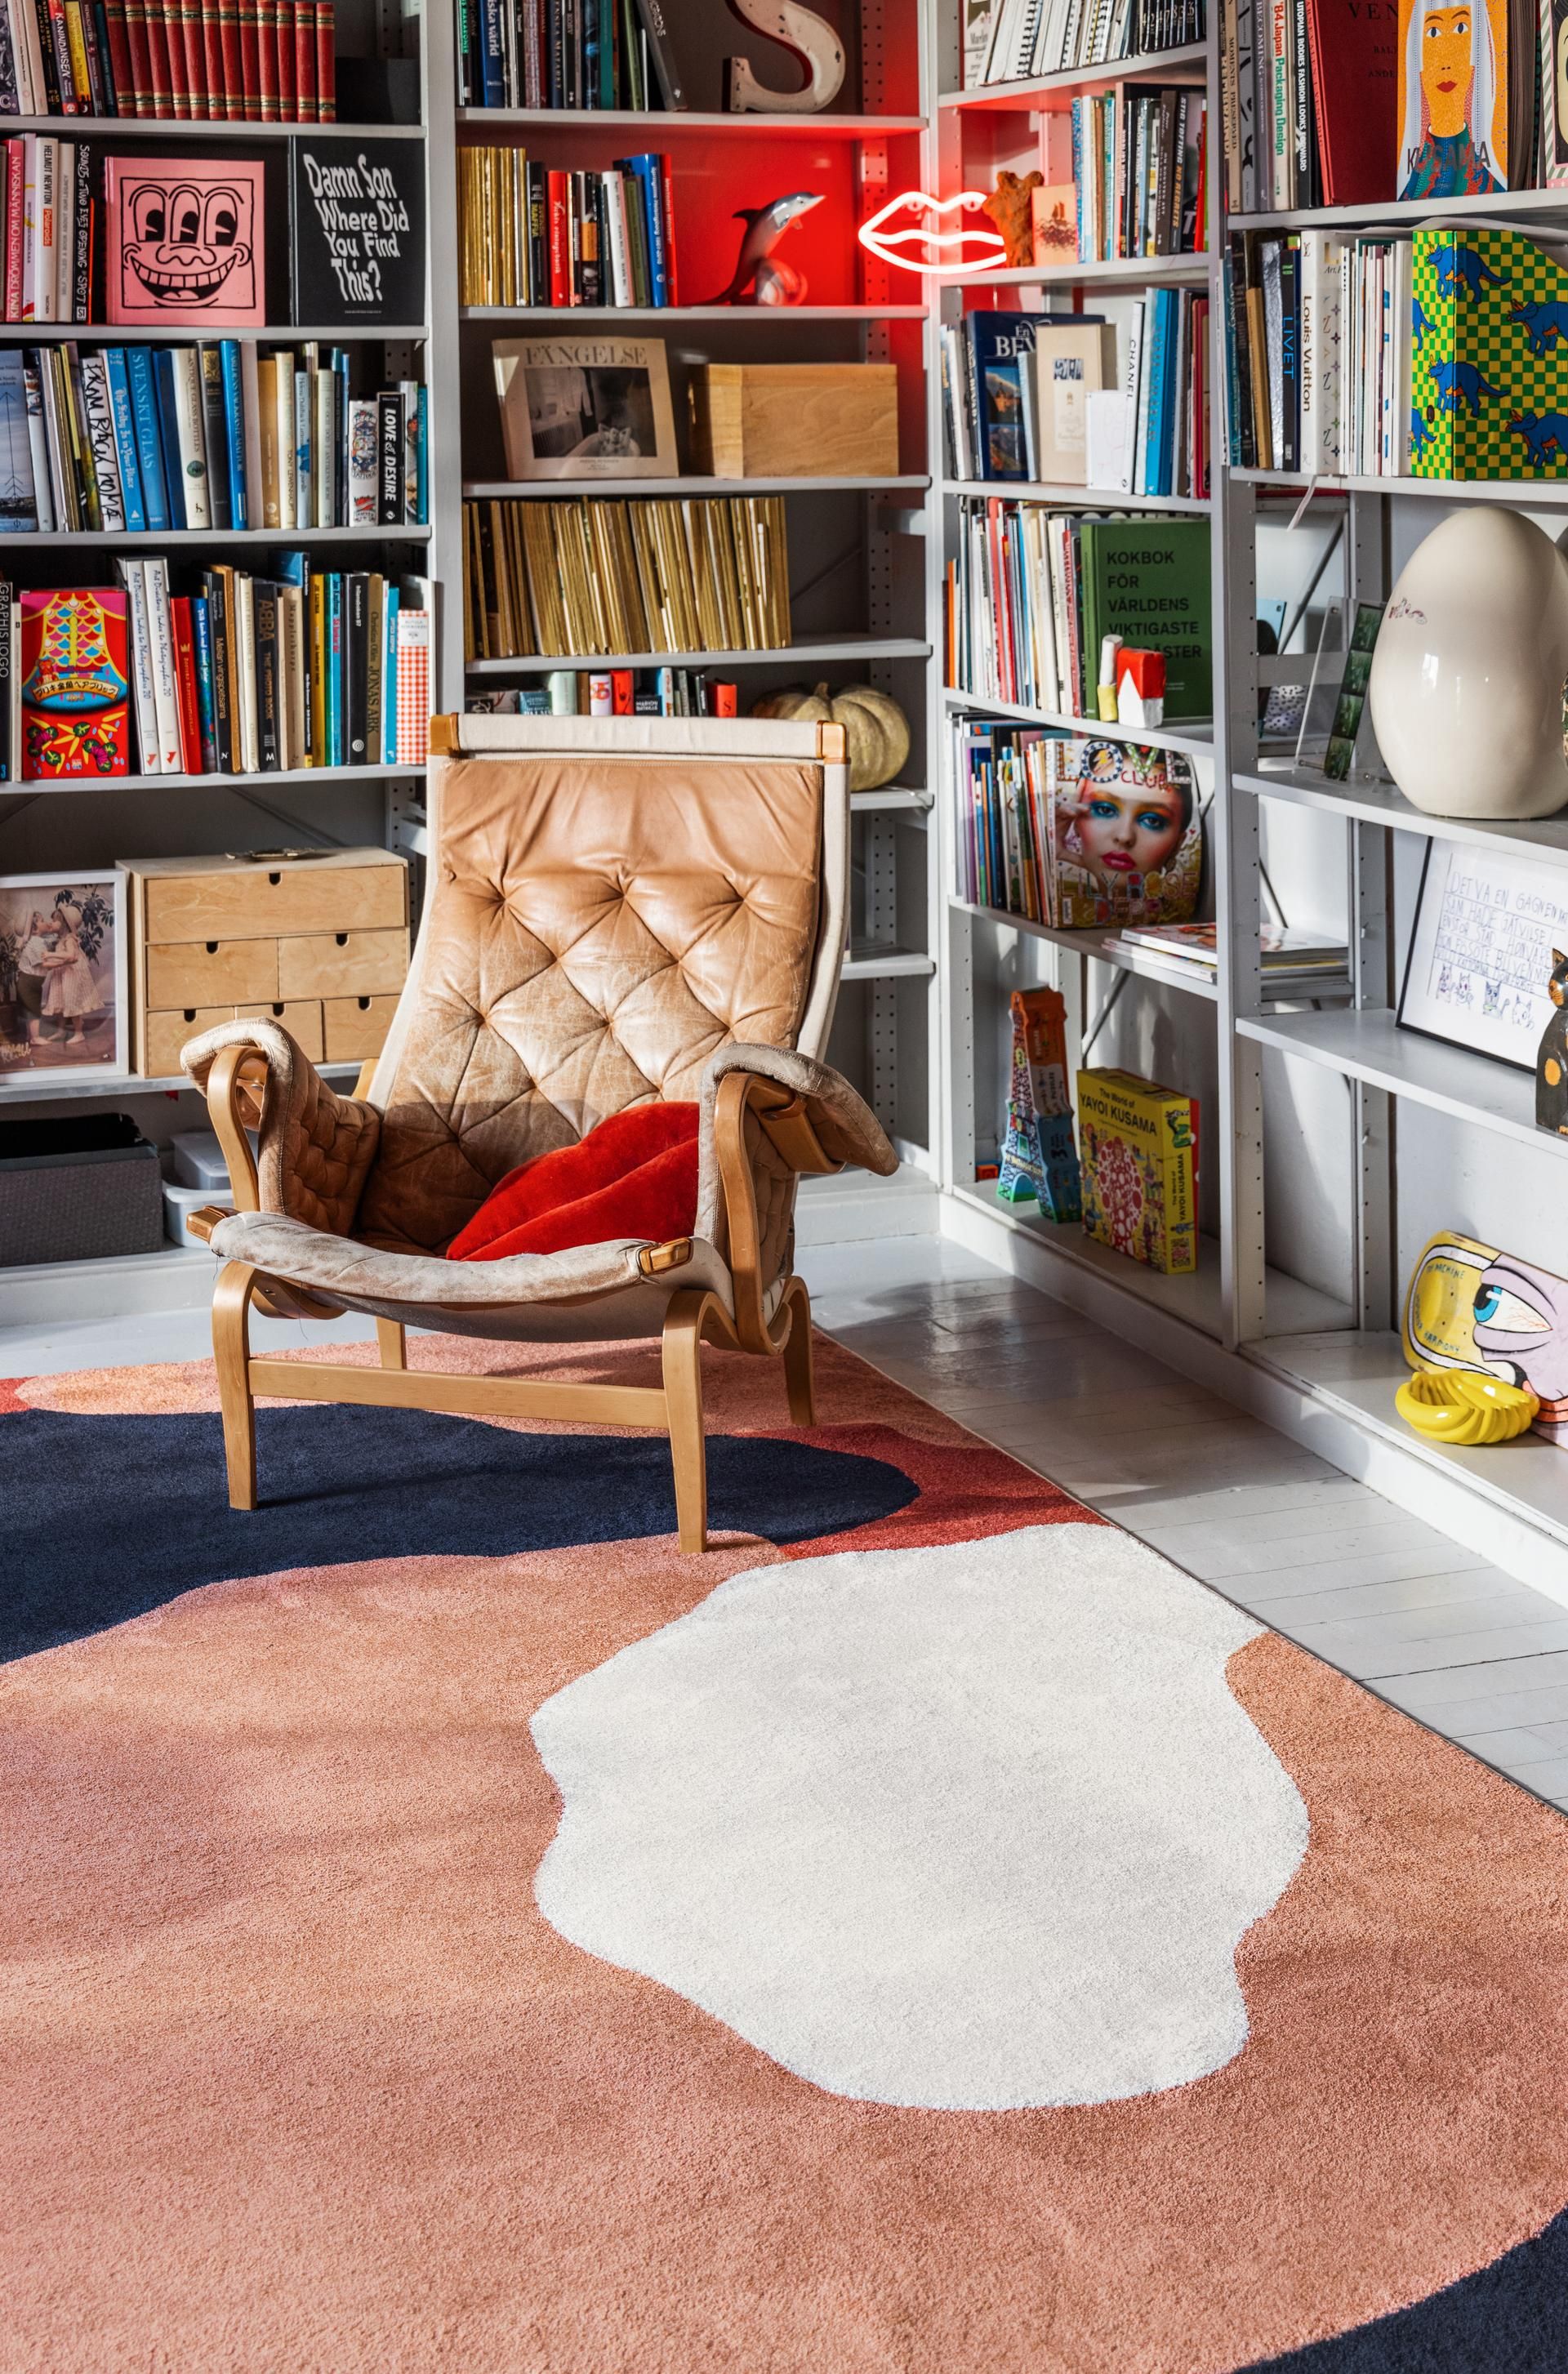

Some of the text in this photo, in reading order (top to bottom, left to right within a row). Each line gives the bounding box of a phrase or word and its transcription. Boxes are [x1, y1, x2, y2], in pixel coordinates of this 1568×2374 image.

[1256, 1, 1266, 75] BECOMING
[1272, 23, 1285, 56] Japan
[1296, 1, 1306, 37] UTOPIAN
[55, 11, 72, 78] KANINDANSEN
[1297, 38, 1306, 67] BODIES
[1273, 57, 1285, 116] Packaging
[1298, 69, 1307, 103] FASHION
[1274, 118, 1286, 155] Design
[1298, 105, 1307, 130] LOOKS
[303, 154, 398, 198] Damn Son
[1407, 141, 1491, 175] KUSAMA
[43, 145, 53, 245] HELMUT NEWTON Polaroids
[314, 198, 409, 231] Where Did
[9, 156, 21, 319] KINA DRÖMMEN OM MÄNNISKAN
[323, 231, 401, 257] You Find
[331, 258, 382, 301] This?
[524, 345, 648, 366] FÄNGELSE
[1282, 316, 1294, 379] LIVET
[1303, 295, 1312, 413] Louis Vuitton
[132, 354, 156, 470] SVENSKT GLAS
[384, 408, 396, 442] LOVE
[384, 455, 396, 502] DESIRE
[1107, 551, 1175, 565] KOKBOK
[1107, 573, 1139, 589] FÖR
[259, 599, 275, 641] ABBA
[1108, 597, 1190, 612] VÄRLDENS
[0, 584, 9, 678] GRAPHIS LOGO
[1108, 621, 1200, 636] VIKTIGASTE
[368, 666, 380, 734] JONAS ARK
[1056, 740, 1193, 785] LOVE
[1080, 1092, 1108, 1117] YAYOI
[1111, 1105, 1158, 1137] KUSAMA
[1177, 1153, 1187, 1222] YAYOI KUSAMA
